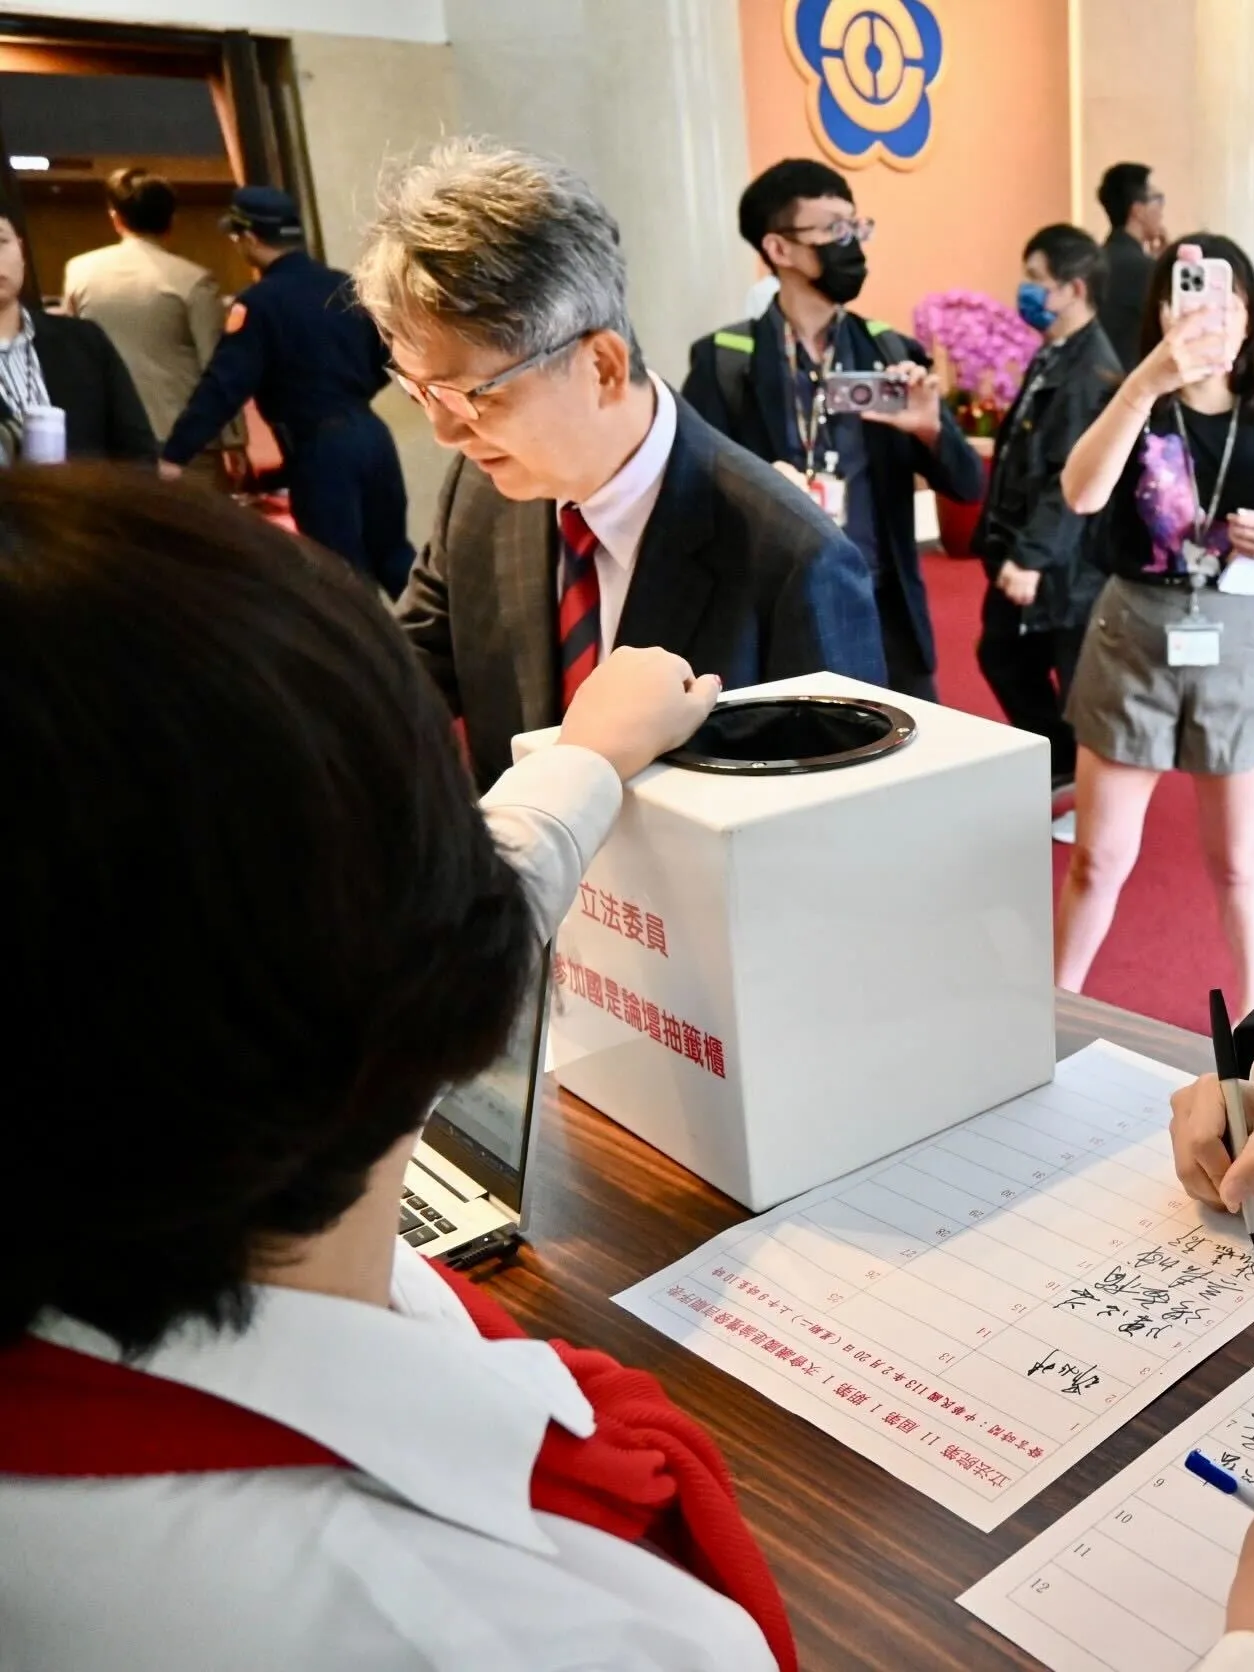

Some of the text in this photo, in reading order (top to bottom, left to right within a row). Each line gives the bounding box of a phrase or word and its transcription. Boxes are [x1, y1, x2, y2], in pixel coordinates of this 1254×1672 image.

[579, 881, 669, 958] 立法委員
[899, 1248, 918, 1258] 27
[864, 1269, 881, 1280] 26
[826, 1293, 845, 1303] 25
[1234, 1295, 1245, 1304] 6
[1010, 1303, 1028, 1314] 15
[938, 1352, 956, 1364] 13
[1139, 1367, 1151, 1375] 3
[1104, 1393, 1118, 1403] 2
[1069, 1422, 1080, 1431] 1
[1225, 1419, 1238, 1428] 7
[920, 1432, 940, 1445] 11
[1153, 1478, 1165, 1488] 9
[1114, 1509, 1133, 1524] 10
[1073, 1543, 1092, 1558] 11
[1030, 1577, 1051, 1594] 12
